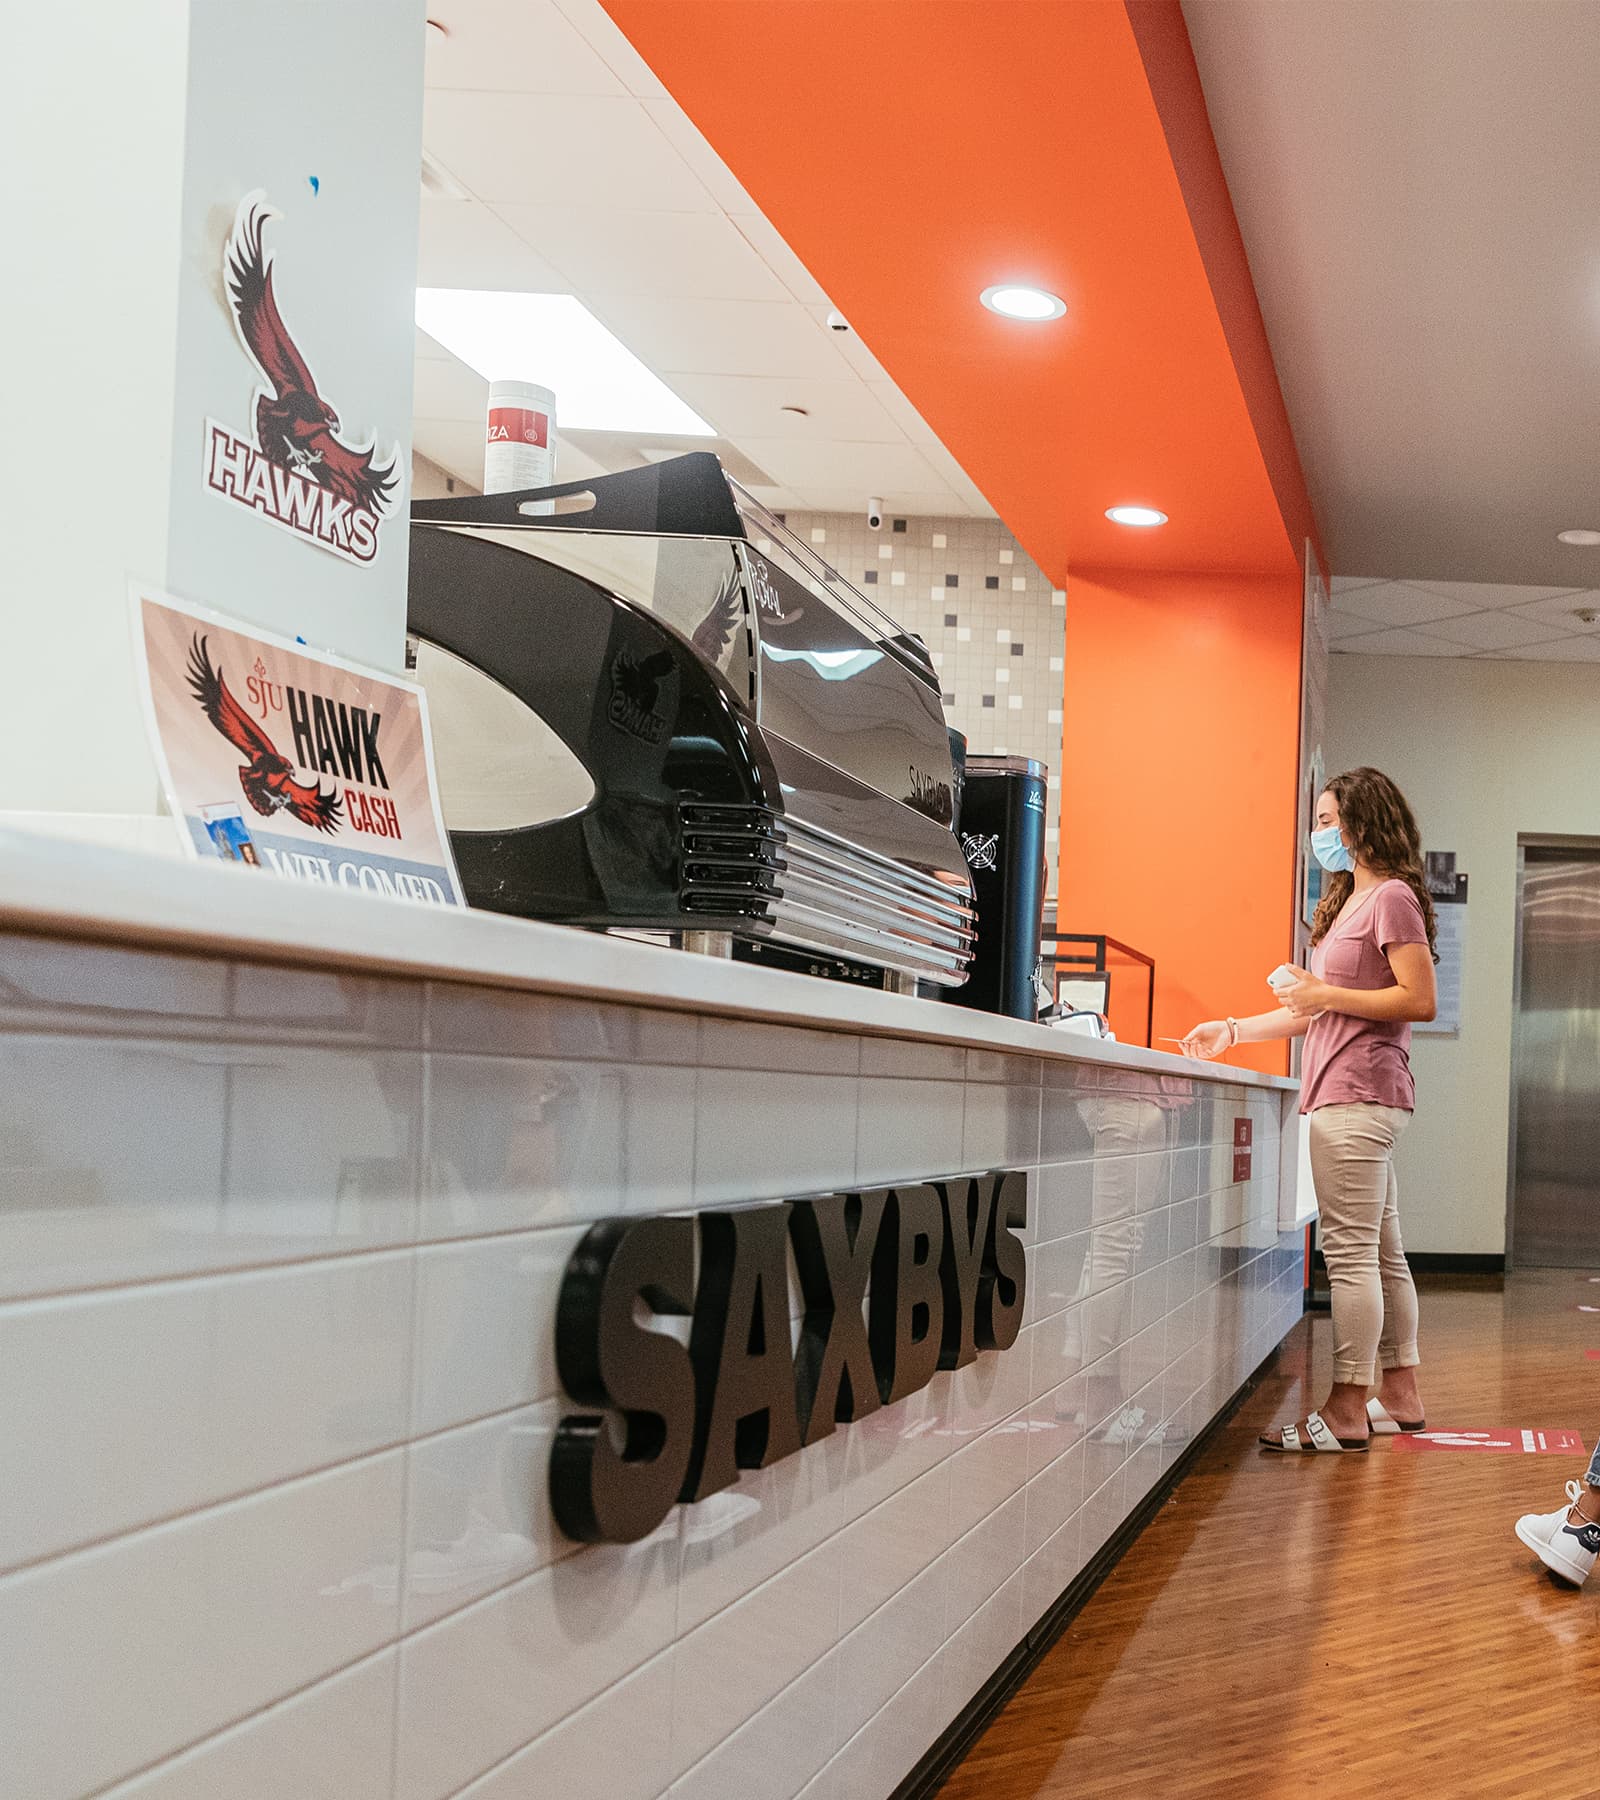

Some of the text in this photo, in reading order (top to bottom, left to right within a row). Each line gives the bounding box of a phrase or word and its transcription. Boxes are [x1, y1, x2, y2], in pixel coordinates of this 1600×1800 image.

[209, 427, 380, 562] HAWKS
[246, 675, 284, 719] SJU
[286, 686, 390, 791] HAWK
[344, 788, 402, 841] CASH
[549, 1170, 1029, 1543] SAXBYS
